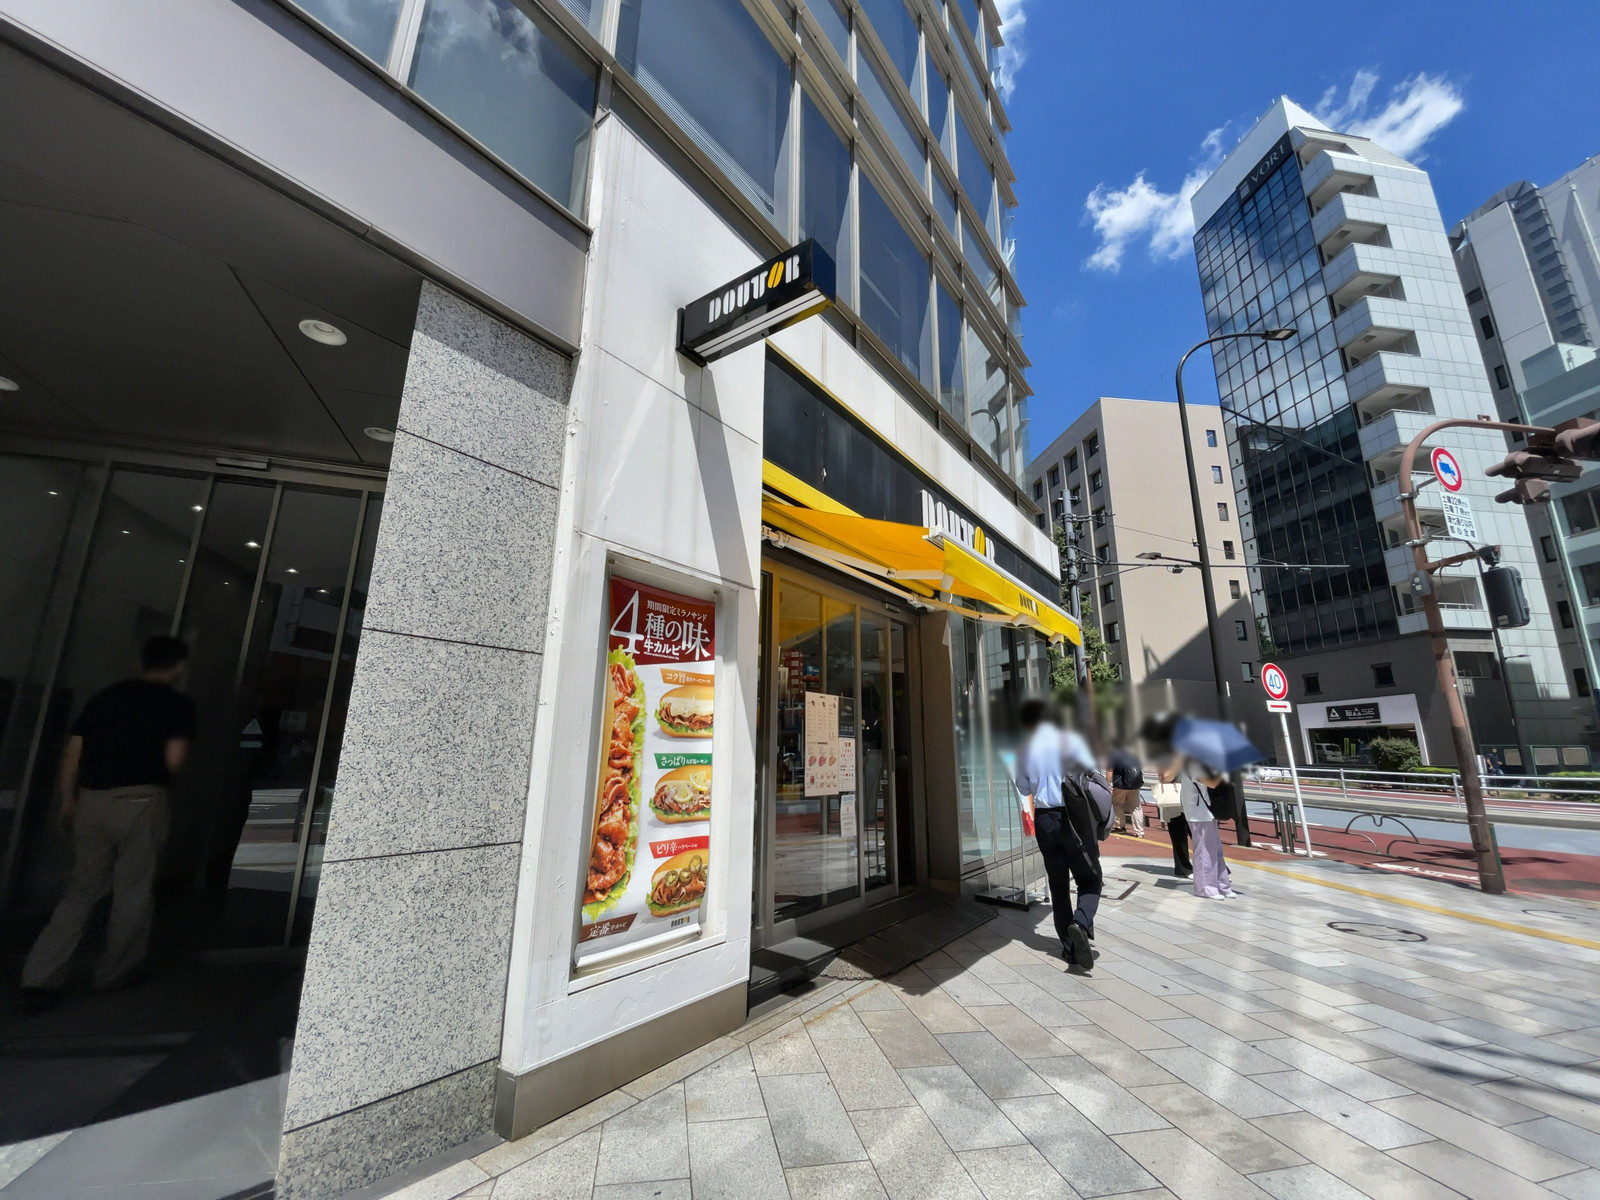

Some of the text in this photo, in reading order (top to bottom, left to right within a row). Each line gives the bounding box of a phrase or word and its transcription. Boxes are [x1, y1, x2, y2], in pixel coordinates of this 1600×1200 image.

[1251, 143, 1285, 183] VORT
[708, 254, 800, 324] DOUTOR
[920, 489, 995, 563] DOUTOR
[610, 590, 711, 661] 4種の味
[646, 599, 708, 622] 期間限定ミラノサンド
[643, 639, 681, 656] 牛カルビ
[1269, 673, 1281, 689] 40
[1345, 707, 1375, 717] BASE
